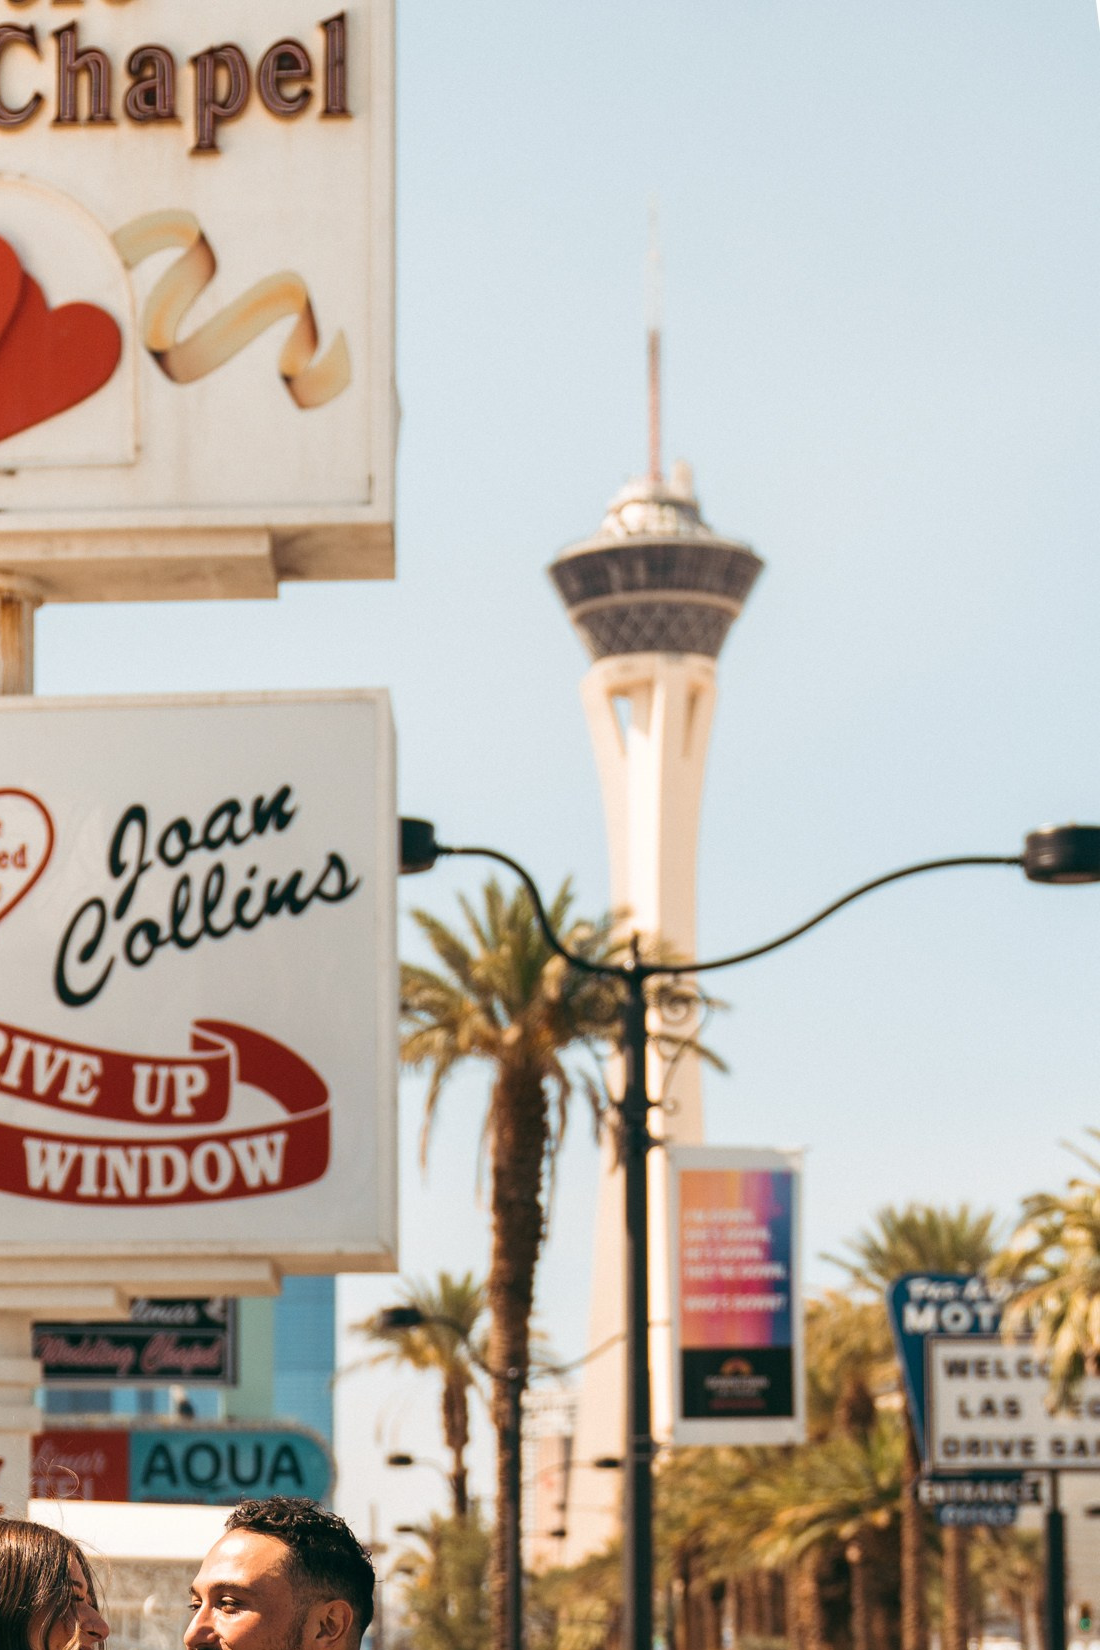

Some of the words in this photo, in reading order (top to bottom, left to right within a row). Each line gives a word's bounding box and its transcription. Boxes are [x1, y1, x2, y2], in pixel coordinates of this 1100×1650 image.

[108, 785, 297, 920] Joan
[54, 852, 361, 1008] Collins
[132, 1063, 208, 1117] UP
[23, 1131, 288, 1198] WINDOW
[903, 1302, 1022, 1334] MOT
[957, 1397, 1021, 1419] LAS
[141, 1440, 305, 1494] AQUA
[942, 1437, 1035, 1459] DRIVE
